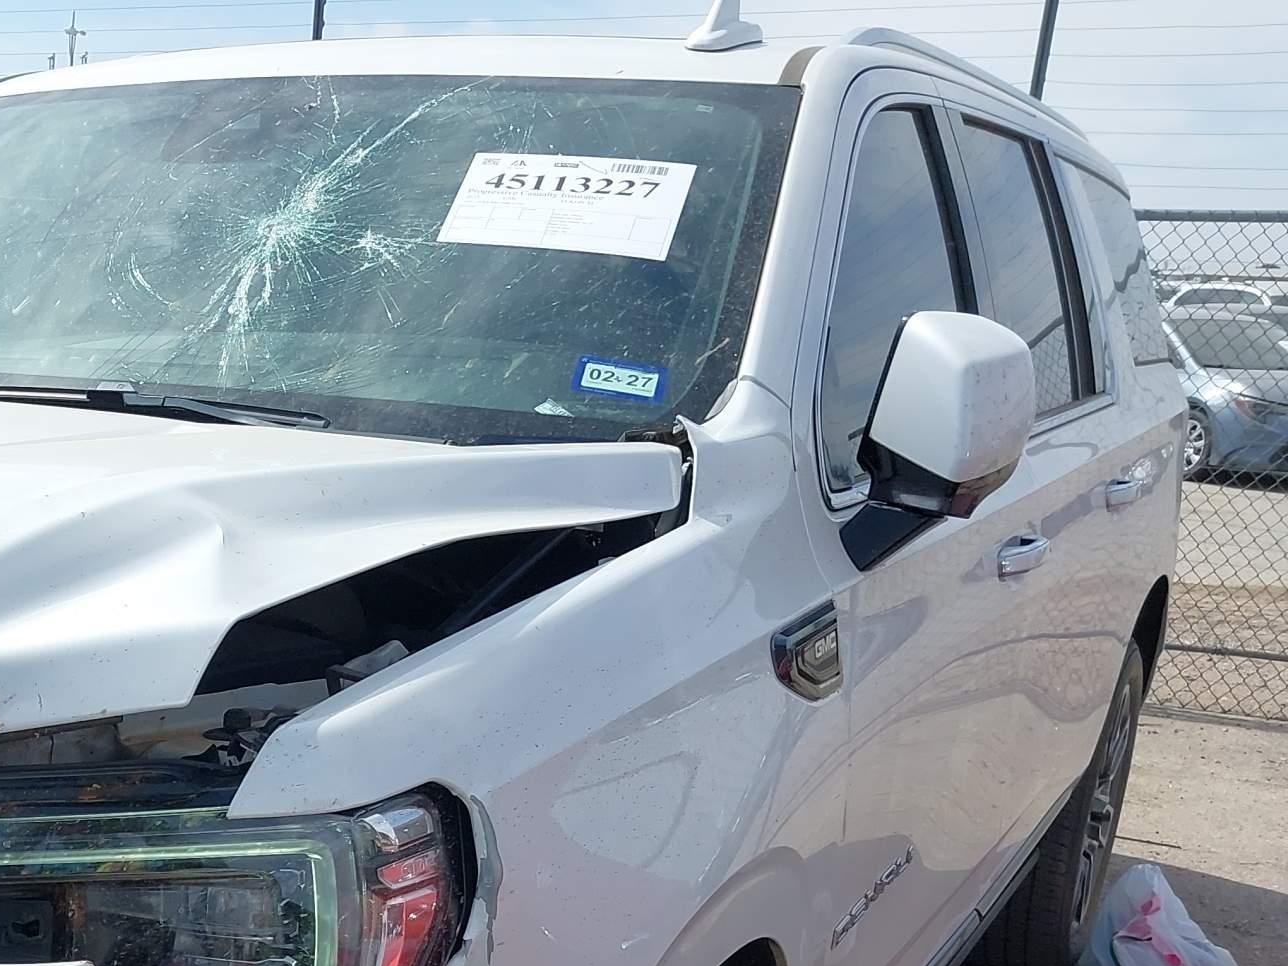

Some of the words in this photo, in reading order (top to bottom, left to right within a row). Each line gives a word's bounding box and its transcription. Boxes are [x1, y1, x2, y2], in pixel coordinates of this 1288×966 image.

[485, 173, 661, 198] 45113227
[589, 368, 615, 383] 02
[625, 374, 654, 388] 27
[814, 631, 836, 659] GMC
